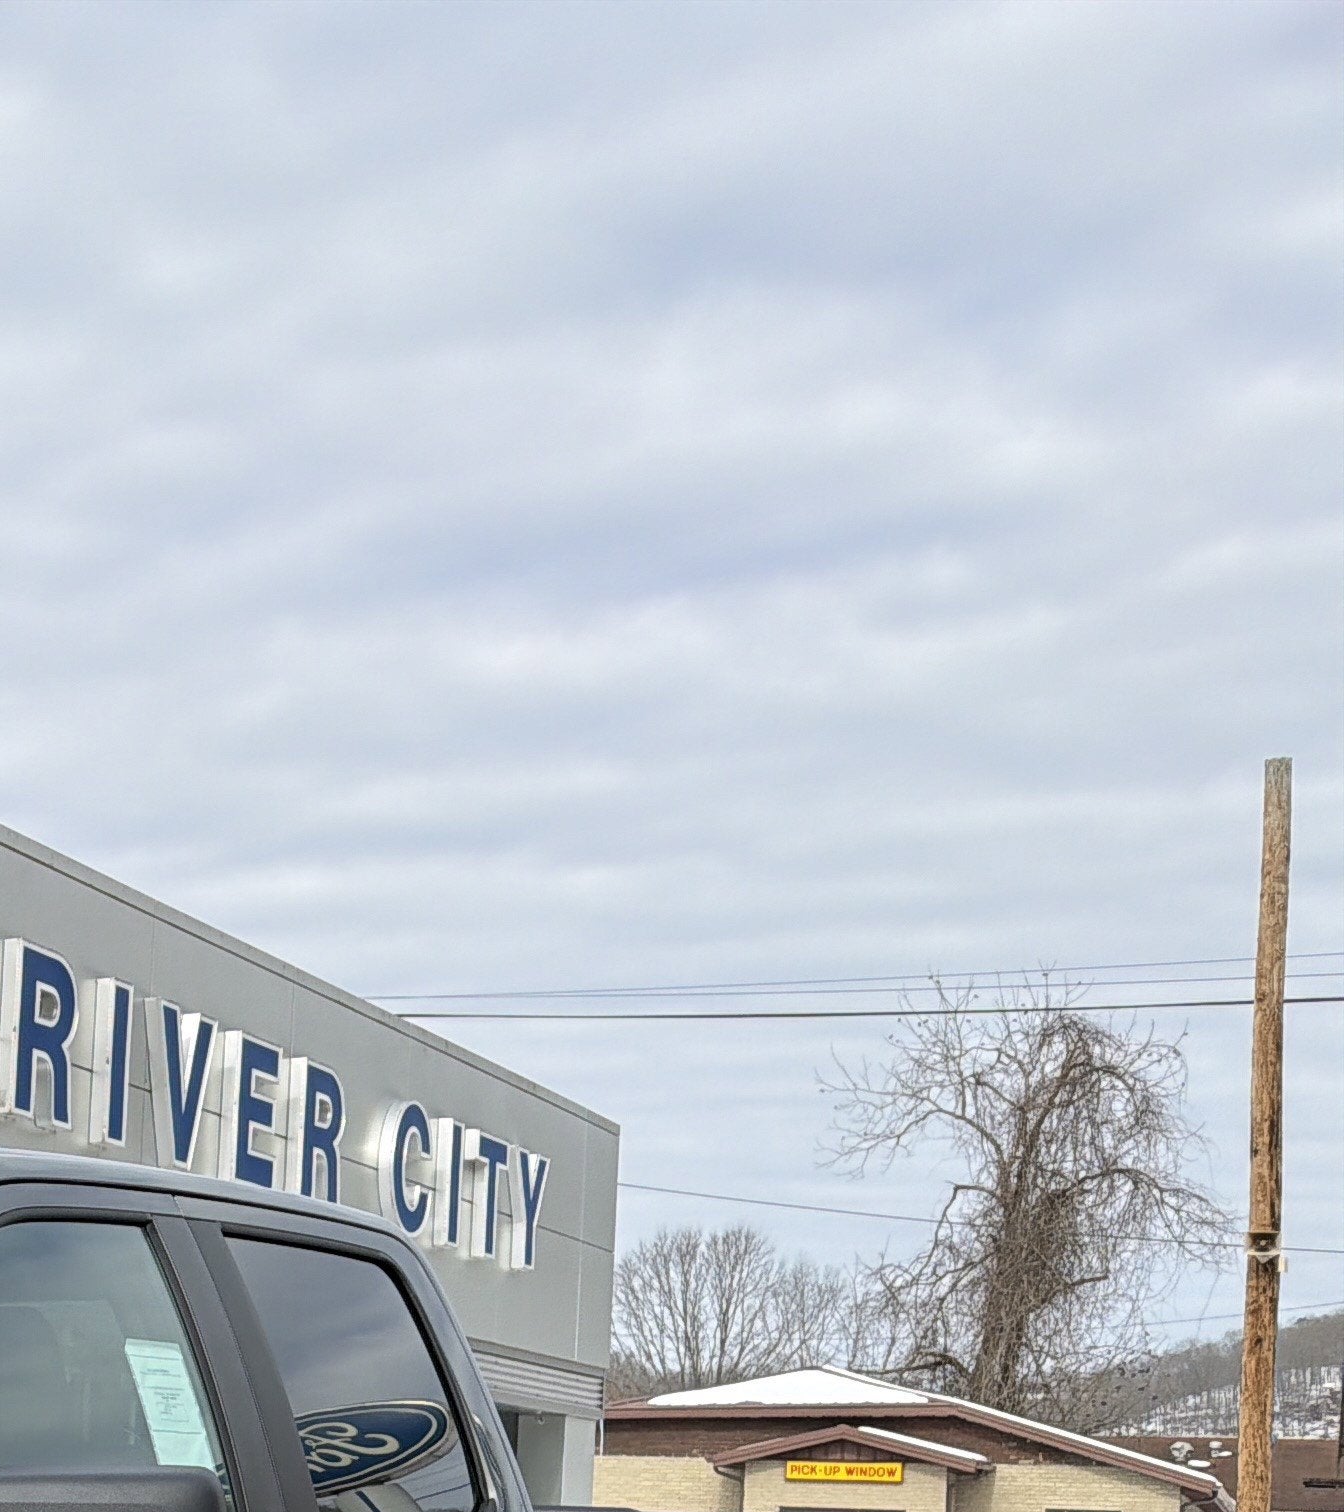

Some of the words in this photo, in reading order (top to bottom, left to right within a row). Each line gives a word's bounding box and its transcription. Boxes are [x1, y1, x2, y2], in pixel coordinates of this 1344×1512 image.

[379, 1100, 551, 1270] CITY
[789, 1463, 840, 1477] PICK-UP
[844, 1465, 898, 1478] WINDOW
